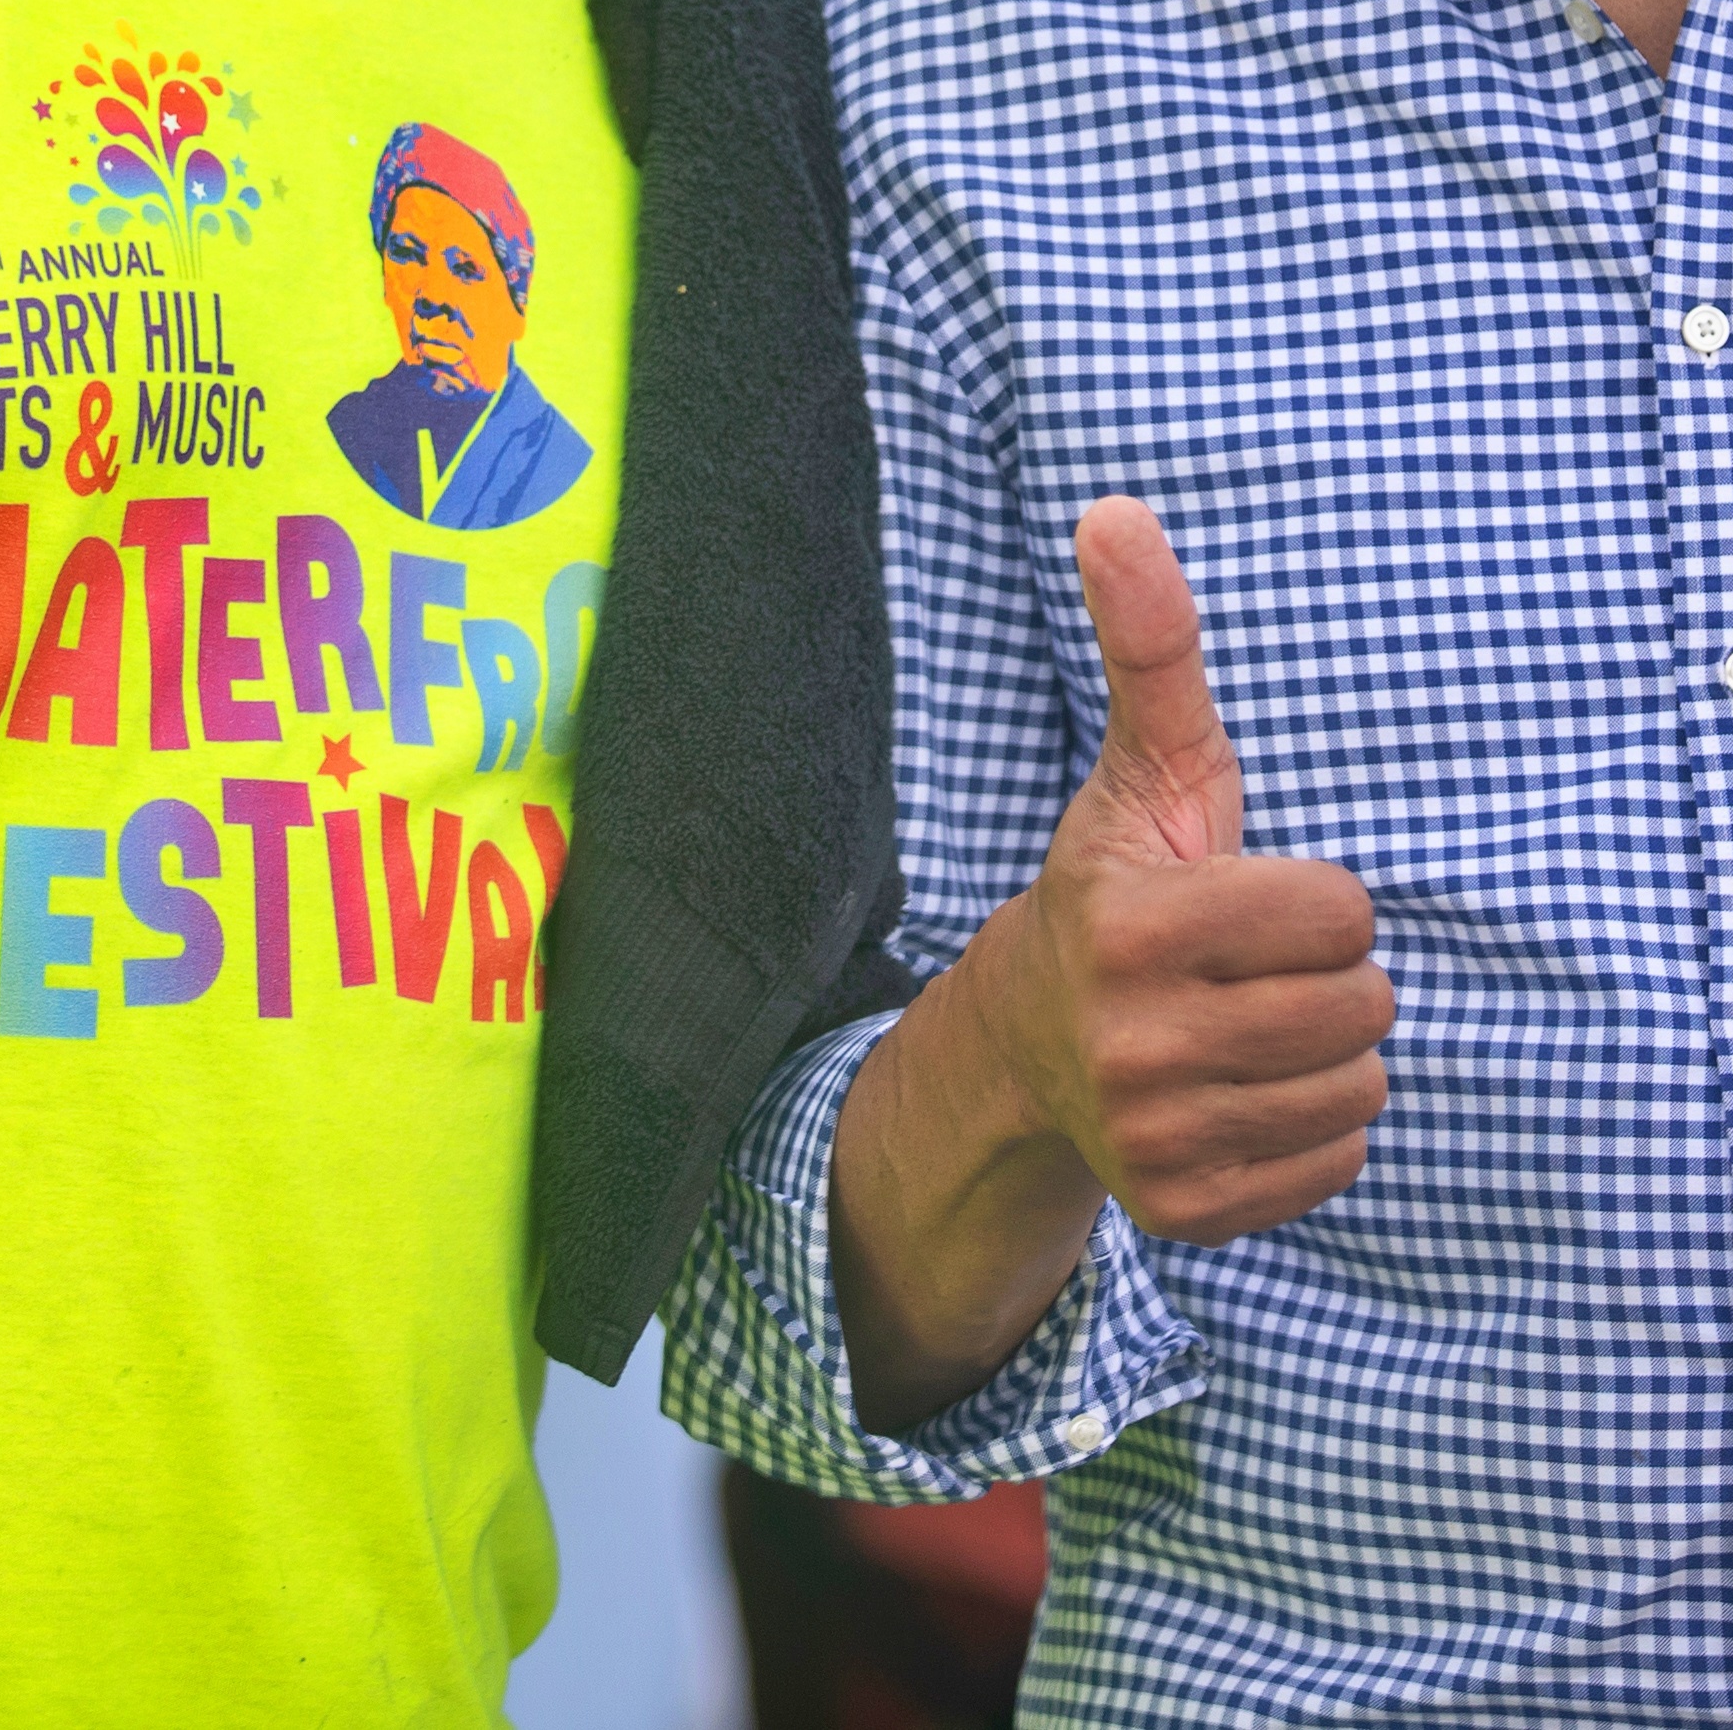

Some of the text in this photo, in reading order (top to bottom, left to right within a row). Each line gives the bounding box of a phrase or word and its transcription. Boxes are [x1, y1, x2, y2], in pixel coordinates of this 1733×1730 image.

[18, 241, 165, 284] ANNUAL
[140, 290, 235, 376] HILL
[64, 380, 120, 497] &
[131, 381, 266, 470] MUSIC
